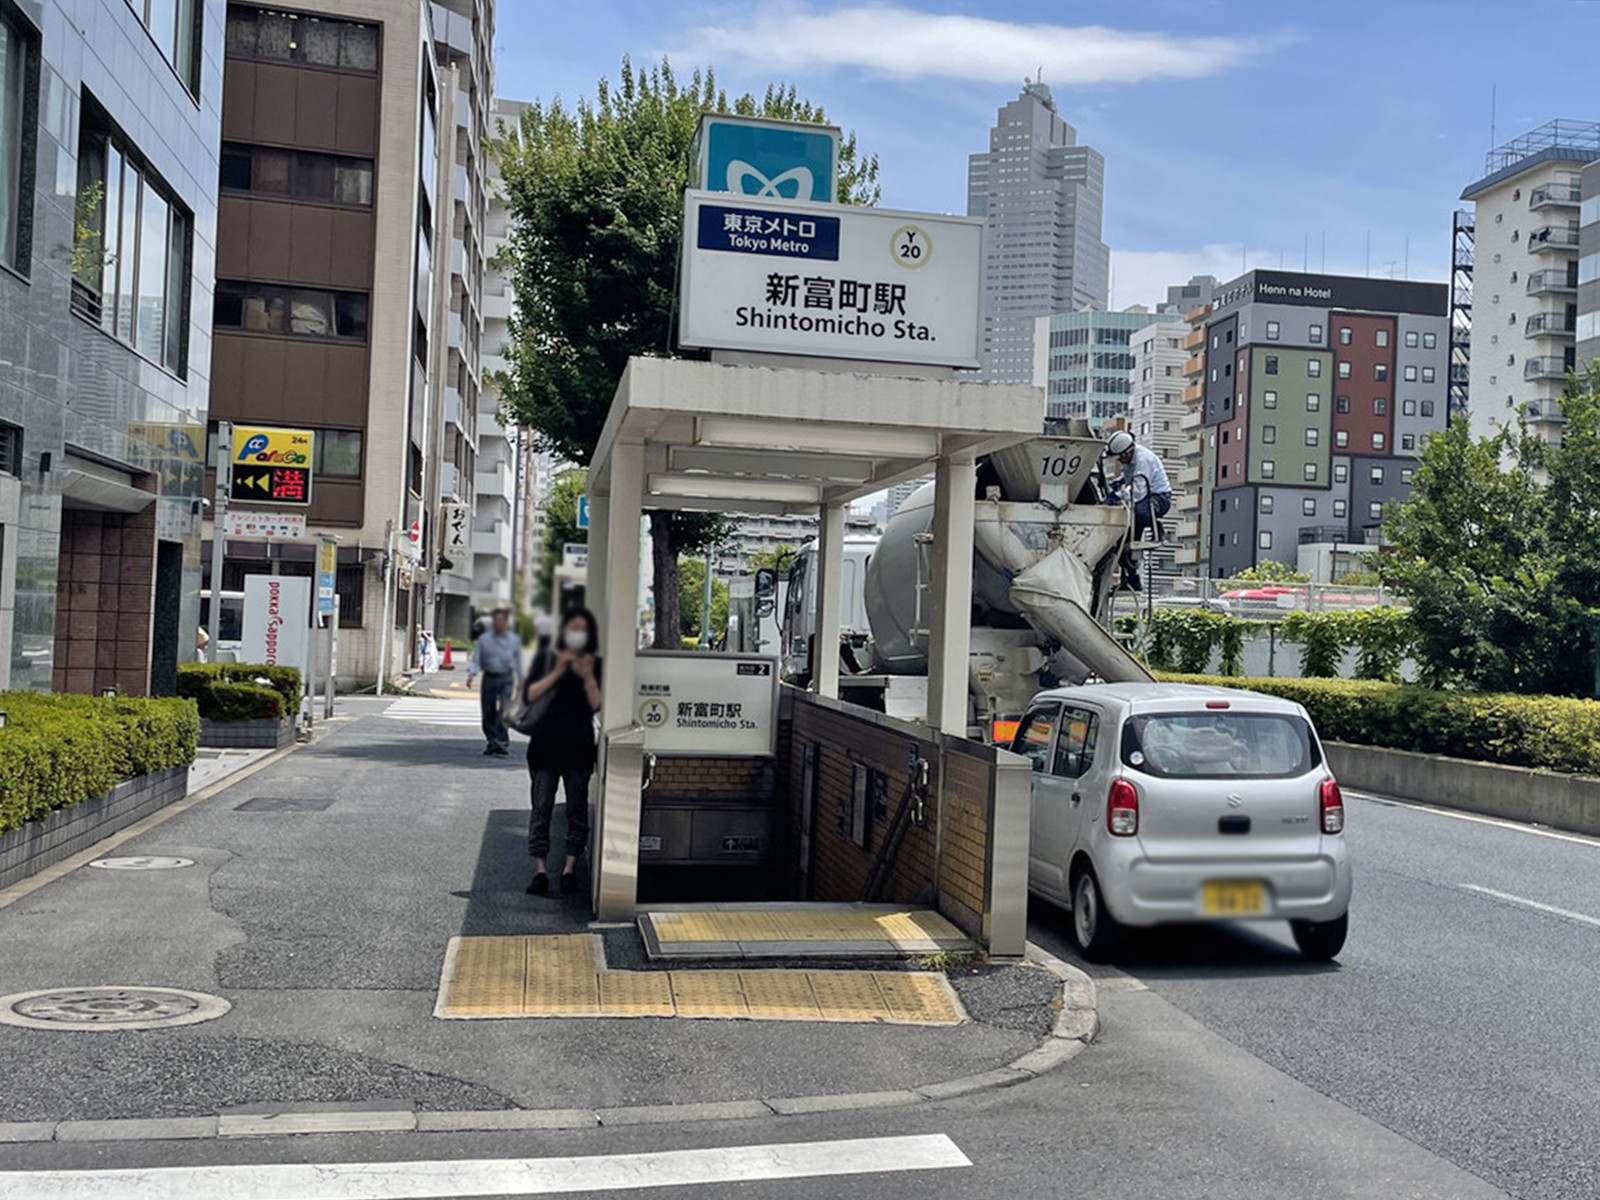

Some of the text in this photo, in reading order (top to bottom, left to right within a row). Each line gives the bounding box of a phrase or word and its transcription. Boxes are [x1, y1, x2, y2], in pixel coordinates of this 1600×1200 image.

[723, 213, 816, 238] 東京メトロ
[728, 233, 810, 253] Tokyo Metro
[906, 230, 918, 244] Y
[900, 245, 921, 260] 20
[765, 272, 906, 317] 新富町駅
[1259, 283, 1332, 299] Henn na Hotel
[736, 306, 936, 341] Shintomicho Sta.
[1042, 455, 1082, 477] 109
[273, 469, 305, 499] 満
[452, 508, 467, 546] おでん
[758, 665, 766, 675] 2
[651, 704, 658, 712] Y
[677, 701, 742, 718] 新富町駅
[646, 713, 662, 722] 20
[676, 718, 759, 729] Shintomicho Sta.
